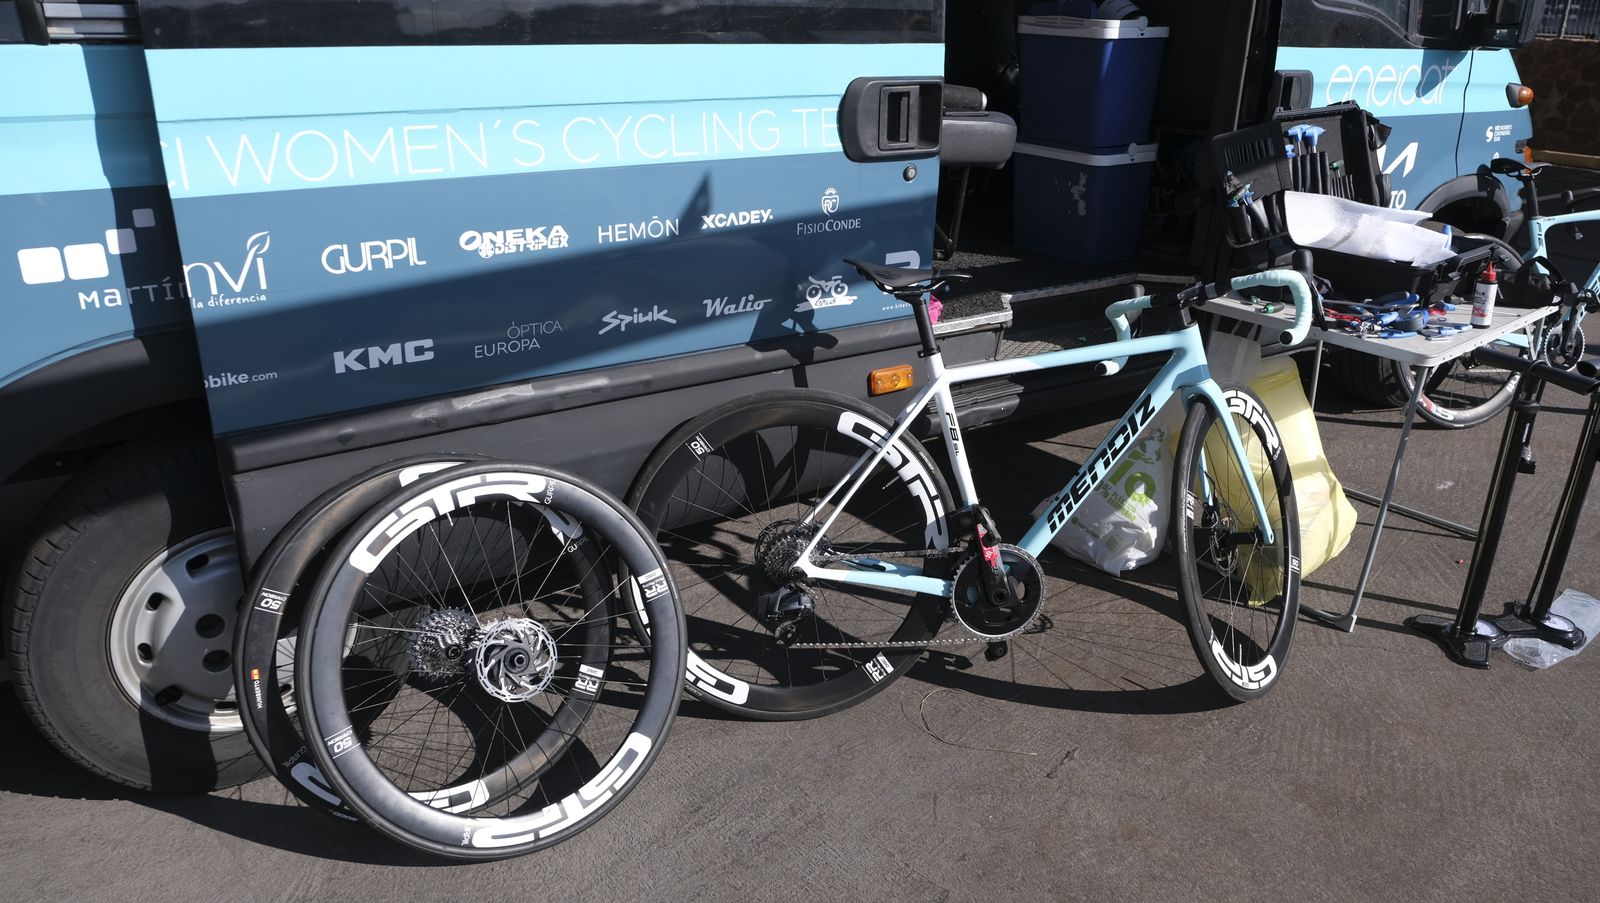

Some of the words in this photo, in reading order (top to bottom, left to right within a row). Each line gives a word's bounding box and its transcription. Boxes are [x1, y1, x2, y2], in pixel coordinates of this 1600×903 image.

[562, 108, 780, 161] CYCLING
[459, 225, 569, 250] ONEKA
[321, 237, 427, 274] GURPIL
[192, 297, 204, 309] la
[208, 293, 267, 308] diferencia
[702, 294, 772, 318] Walio
[507, 320, 563, 340] ÓPTICA
[599, 305, 677, 335] Spiuk
[334, 338, 434, 374] KMC
[474, 338, 540, 359] EUROPA
[690, 441, 705, 455] 50
[260, 598, 282, 610] 50
[333, 738, 353, 752] 50
